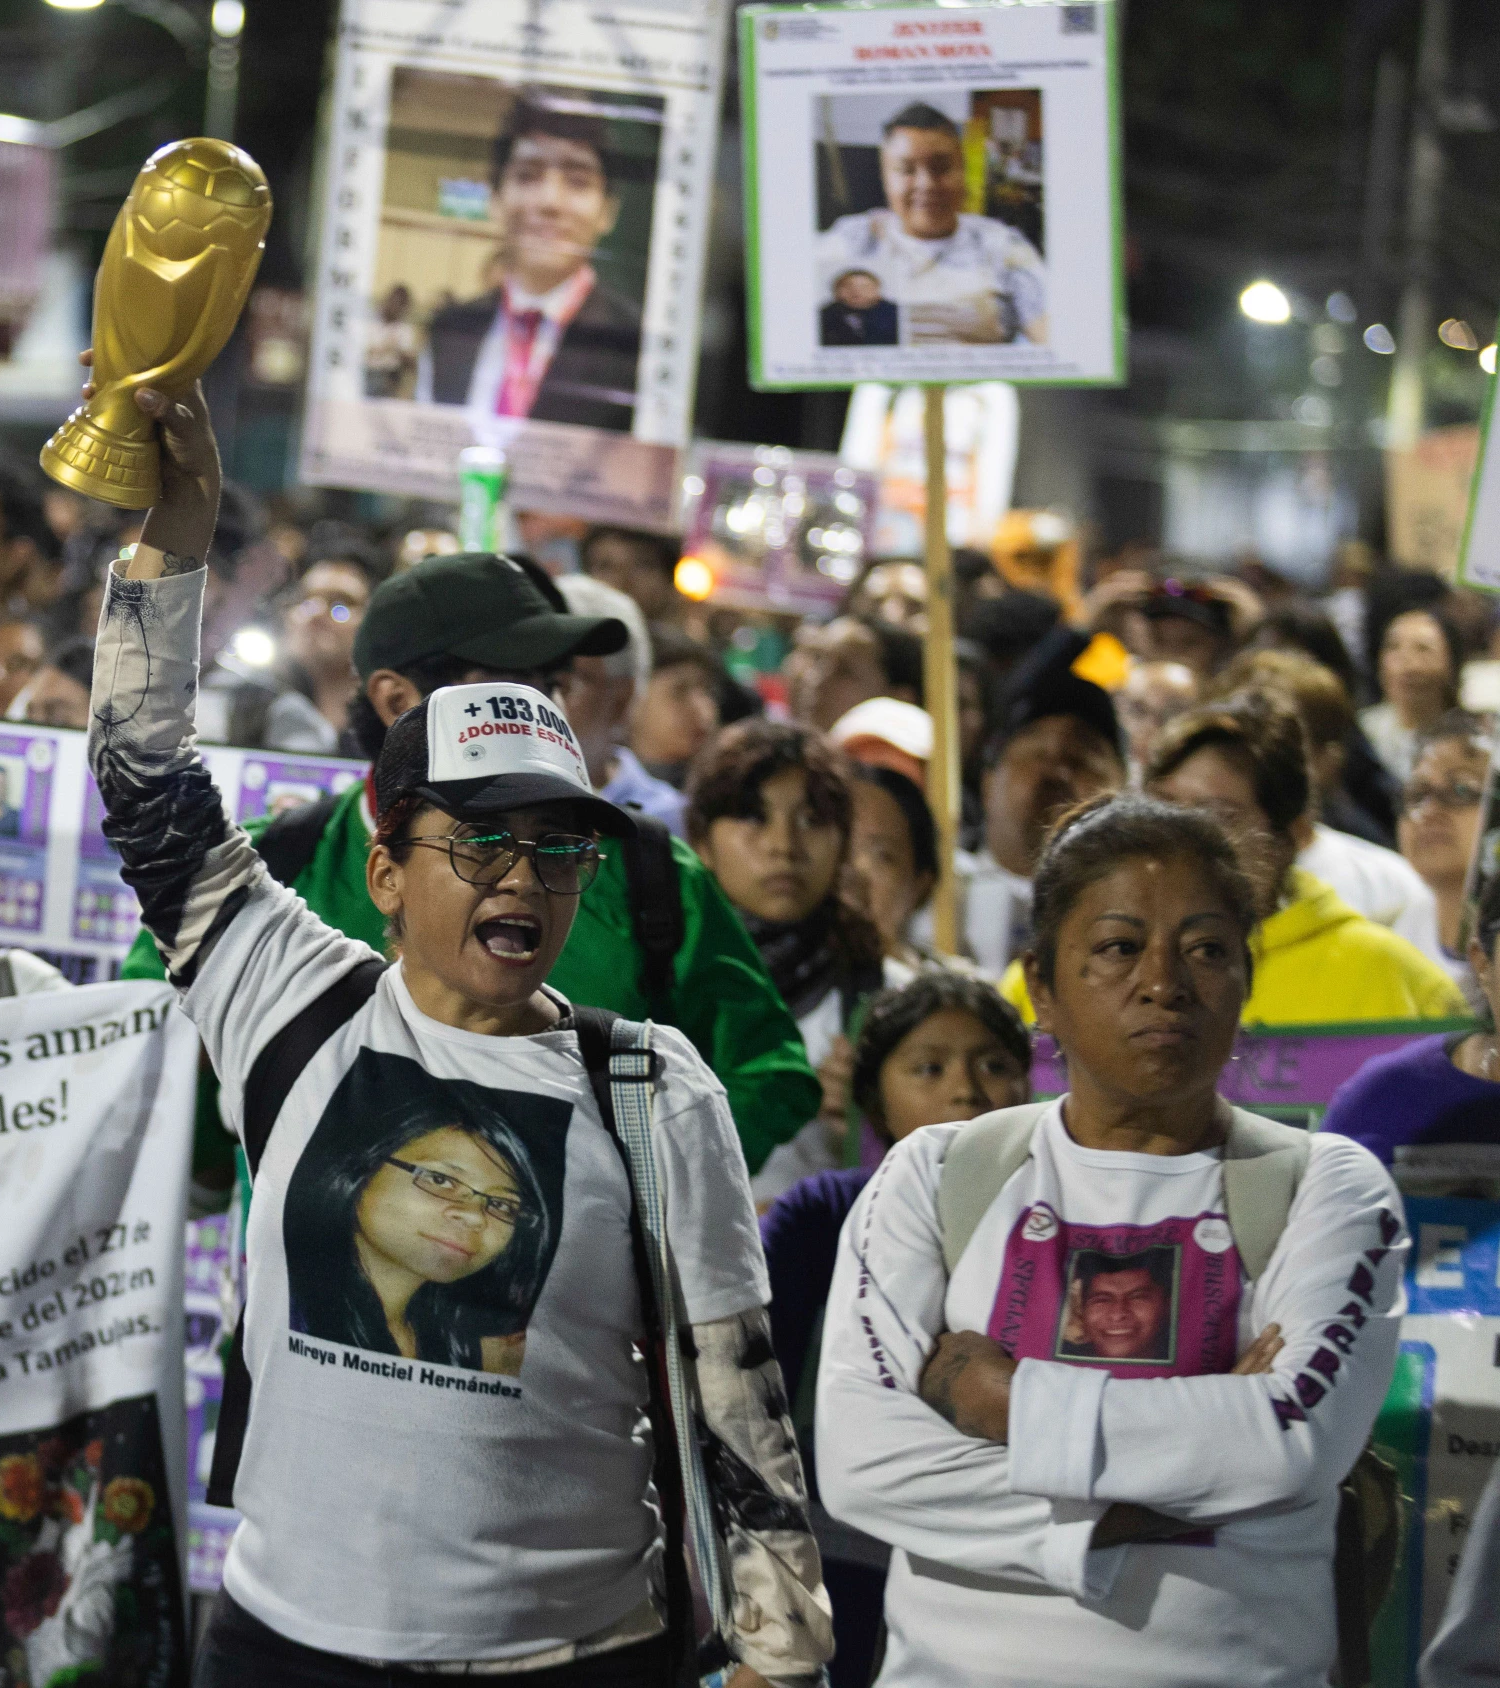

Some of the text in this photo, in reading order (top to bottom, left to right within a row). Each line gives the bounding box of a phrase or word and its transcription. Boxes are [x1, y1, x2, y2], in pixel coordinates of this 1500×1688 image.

[458, 721, 532, 744] ¿DÓNDE
[63, 1235, 90, 1268] el
[20, 1291, 68, 1331] del
[288, 1335, 523, 1399] Mireya Montiel Hernández
